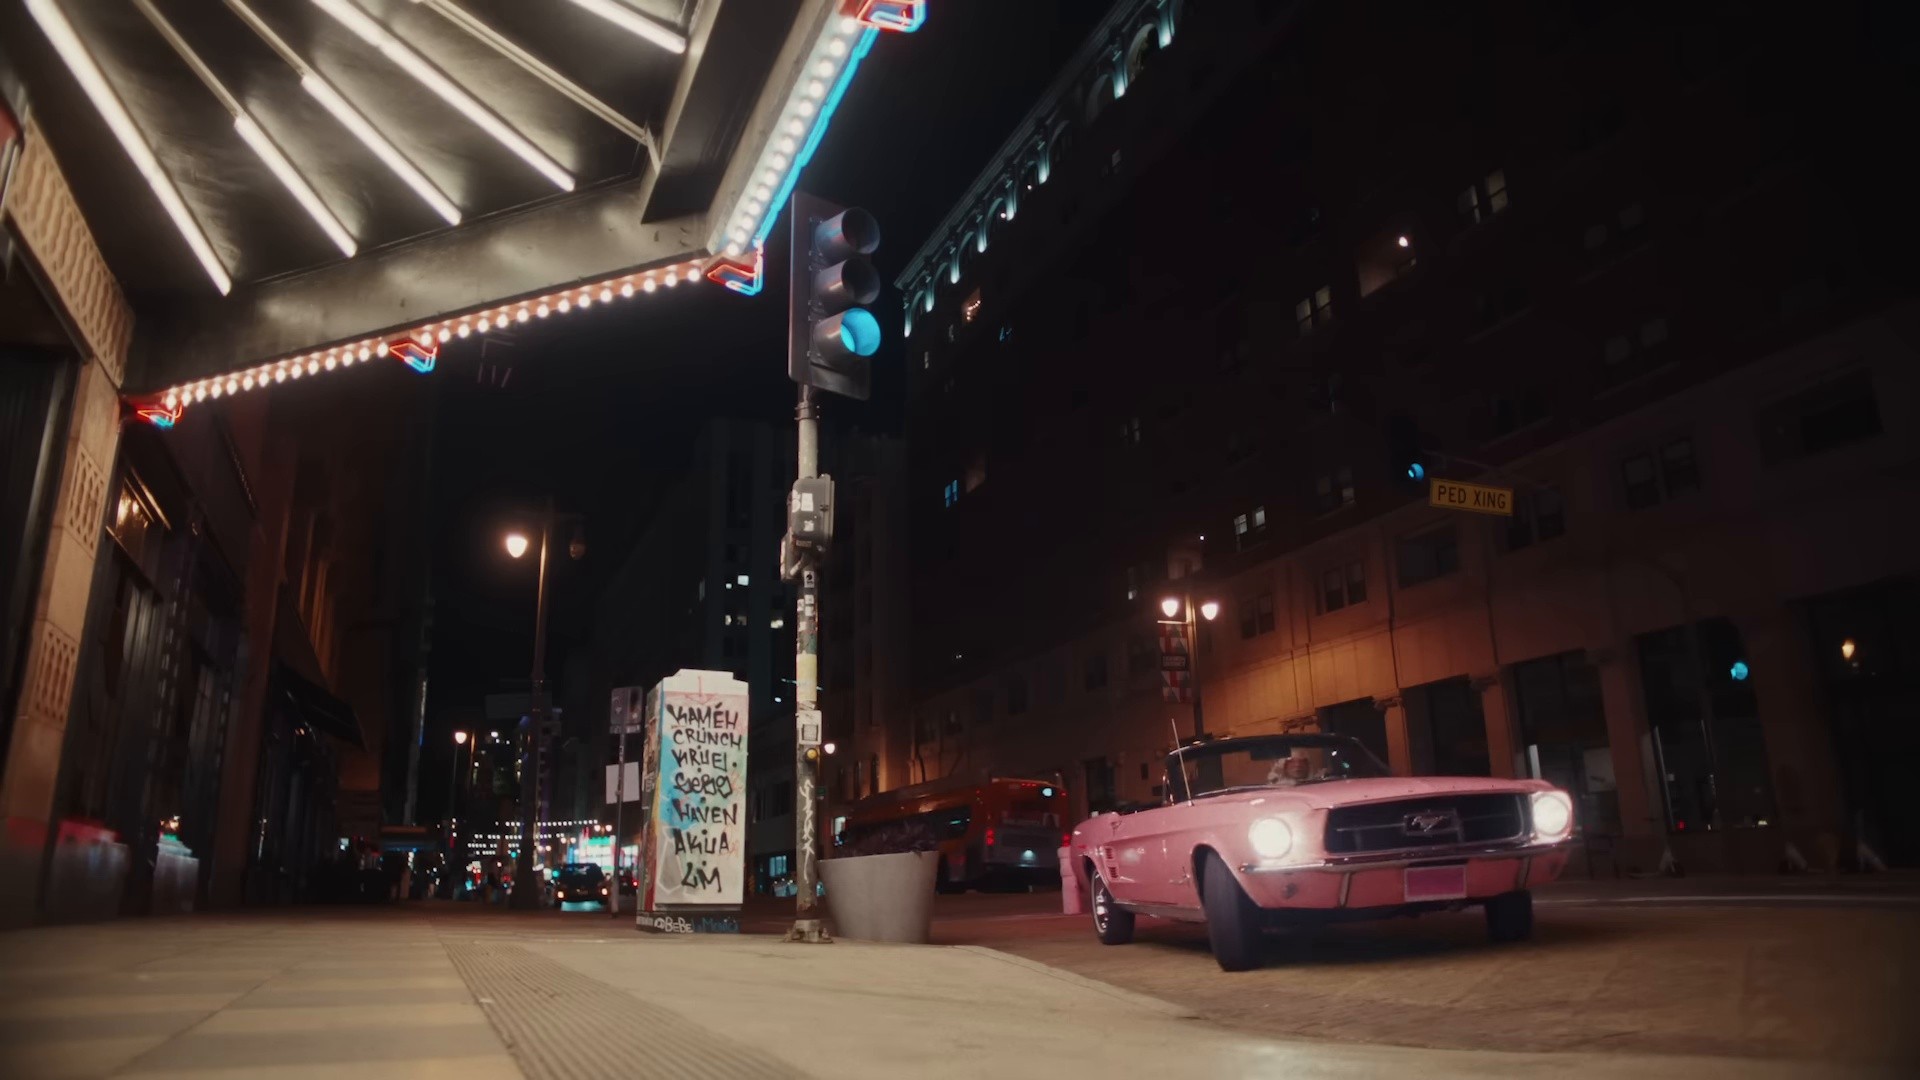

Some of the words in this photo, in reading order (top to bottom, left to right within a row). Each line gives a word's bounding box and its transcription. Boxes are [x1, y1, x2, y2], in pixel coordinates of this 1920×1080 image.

[1437, 485, 1467, 504] PED
[1473, 488, 1506, 509] XING
[673, 728, 742, 751] CRUNCH
[671, 798, 737, 825] HAVEN
